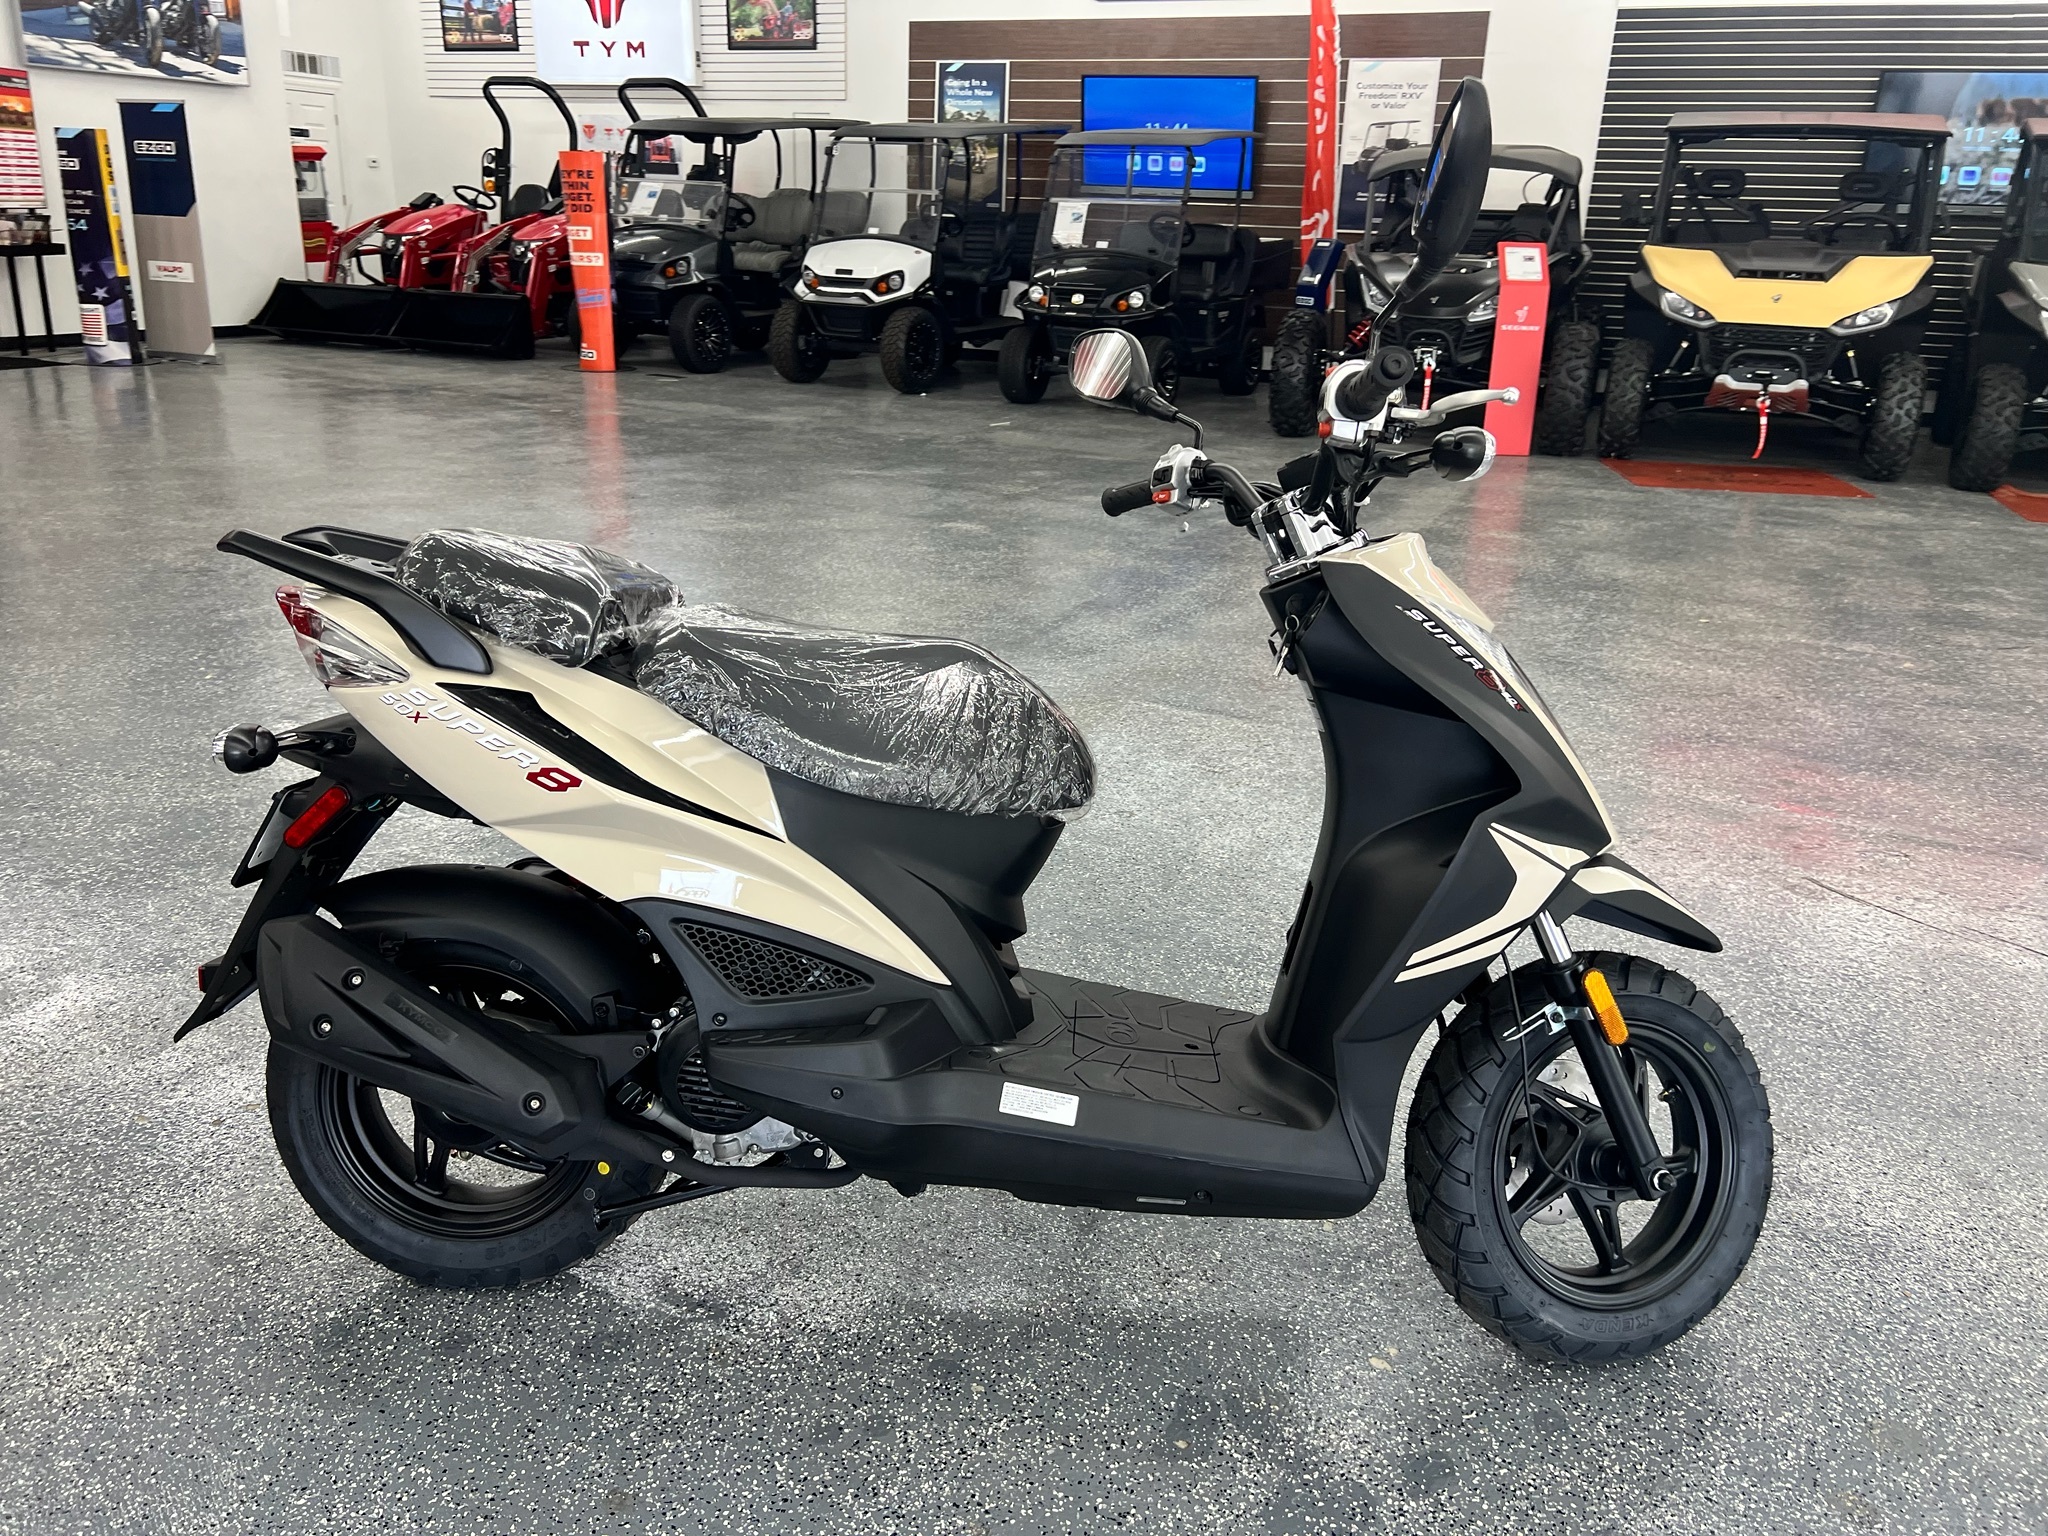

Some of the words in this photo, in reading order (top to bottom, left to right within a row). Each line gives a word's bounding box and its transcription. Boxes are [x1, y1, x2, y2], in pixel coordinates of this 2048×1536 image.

[573, 40, 645, 58] TYM
[1356, 82, 1403, 90] Customize
[1406, 82, 1428, 90] Your
[1963, 126, 2025, 143] 11:4
[571, 204, 593, 212] DID
[1402, 608, 1484, 670] SUPER
[379, 692, 429, 724] 50X
[400, 687, 541, 769] SUPER
[525, 767, 583, 792] 8
